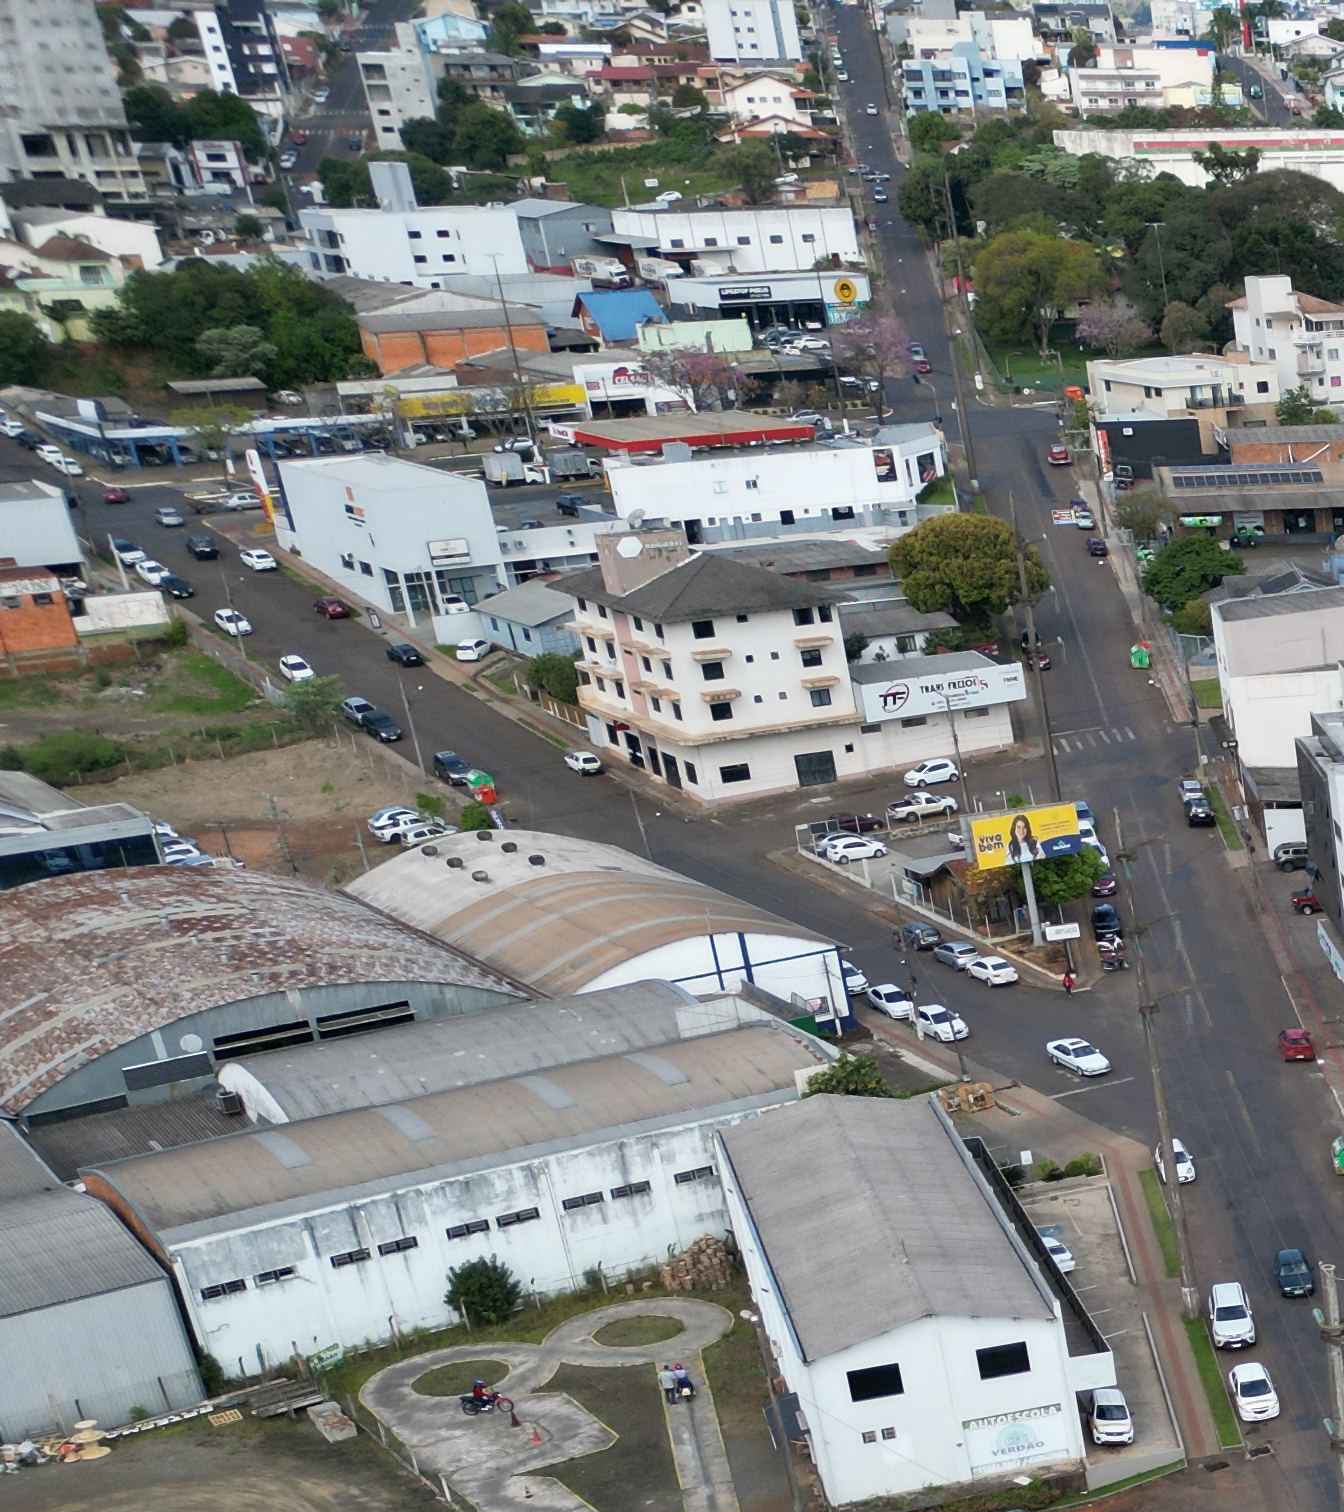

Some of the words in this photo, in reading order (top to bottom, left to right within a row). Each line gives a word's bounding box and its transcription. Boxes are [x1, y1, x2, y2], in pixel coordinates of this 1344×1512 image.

[979, 833, 1003, 844] viva
[968, 1405, 1059, 1431] AUTOESCOLA
[991, 1440, 1045, 1456] VERDÃO
